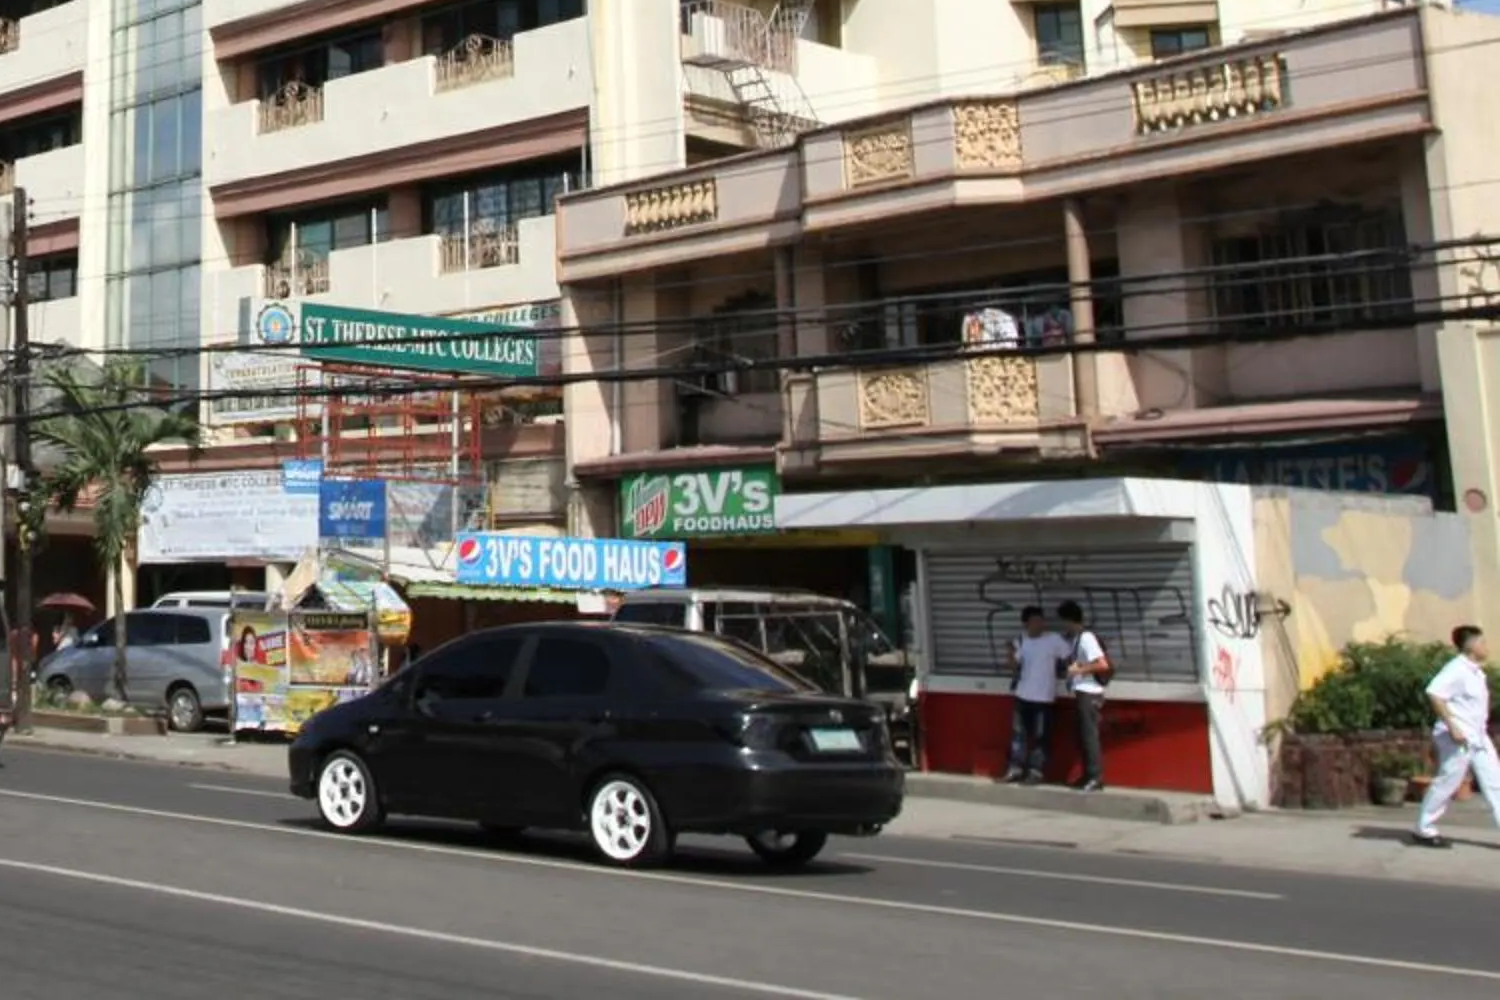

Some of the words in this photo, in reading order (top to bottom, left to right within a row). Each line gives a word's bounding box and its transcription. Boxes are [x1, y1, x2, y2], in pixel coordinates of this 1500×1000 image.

[303, 316, 328, 343] ST.
[451, 332, 534, 366] COLLEGES
[674, 471, 770, 515] 3V's
[673, 514, 773, 532] FOODHAUS
[485, 538, 532, 579] 3V'S
[539, 541, 597, 582] FOOD
[604, 544, 661, 585] HAUS
